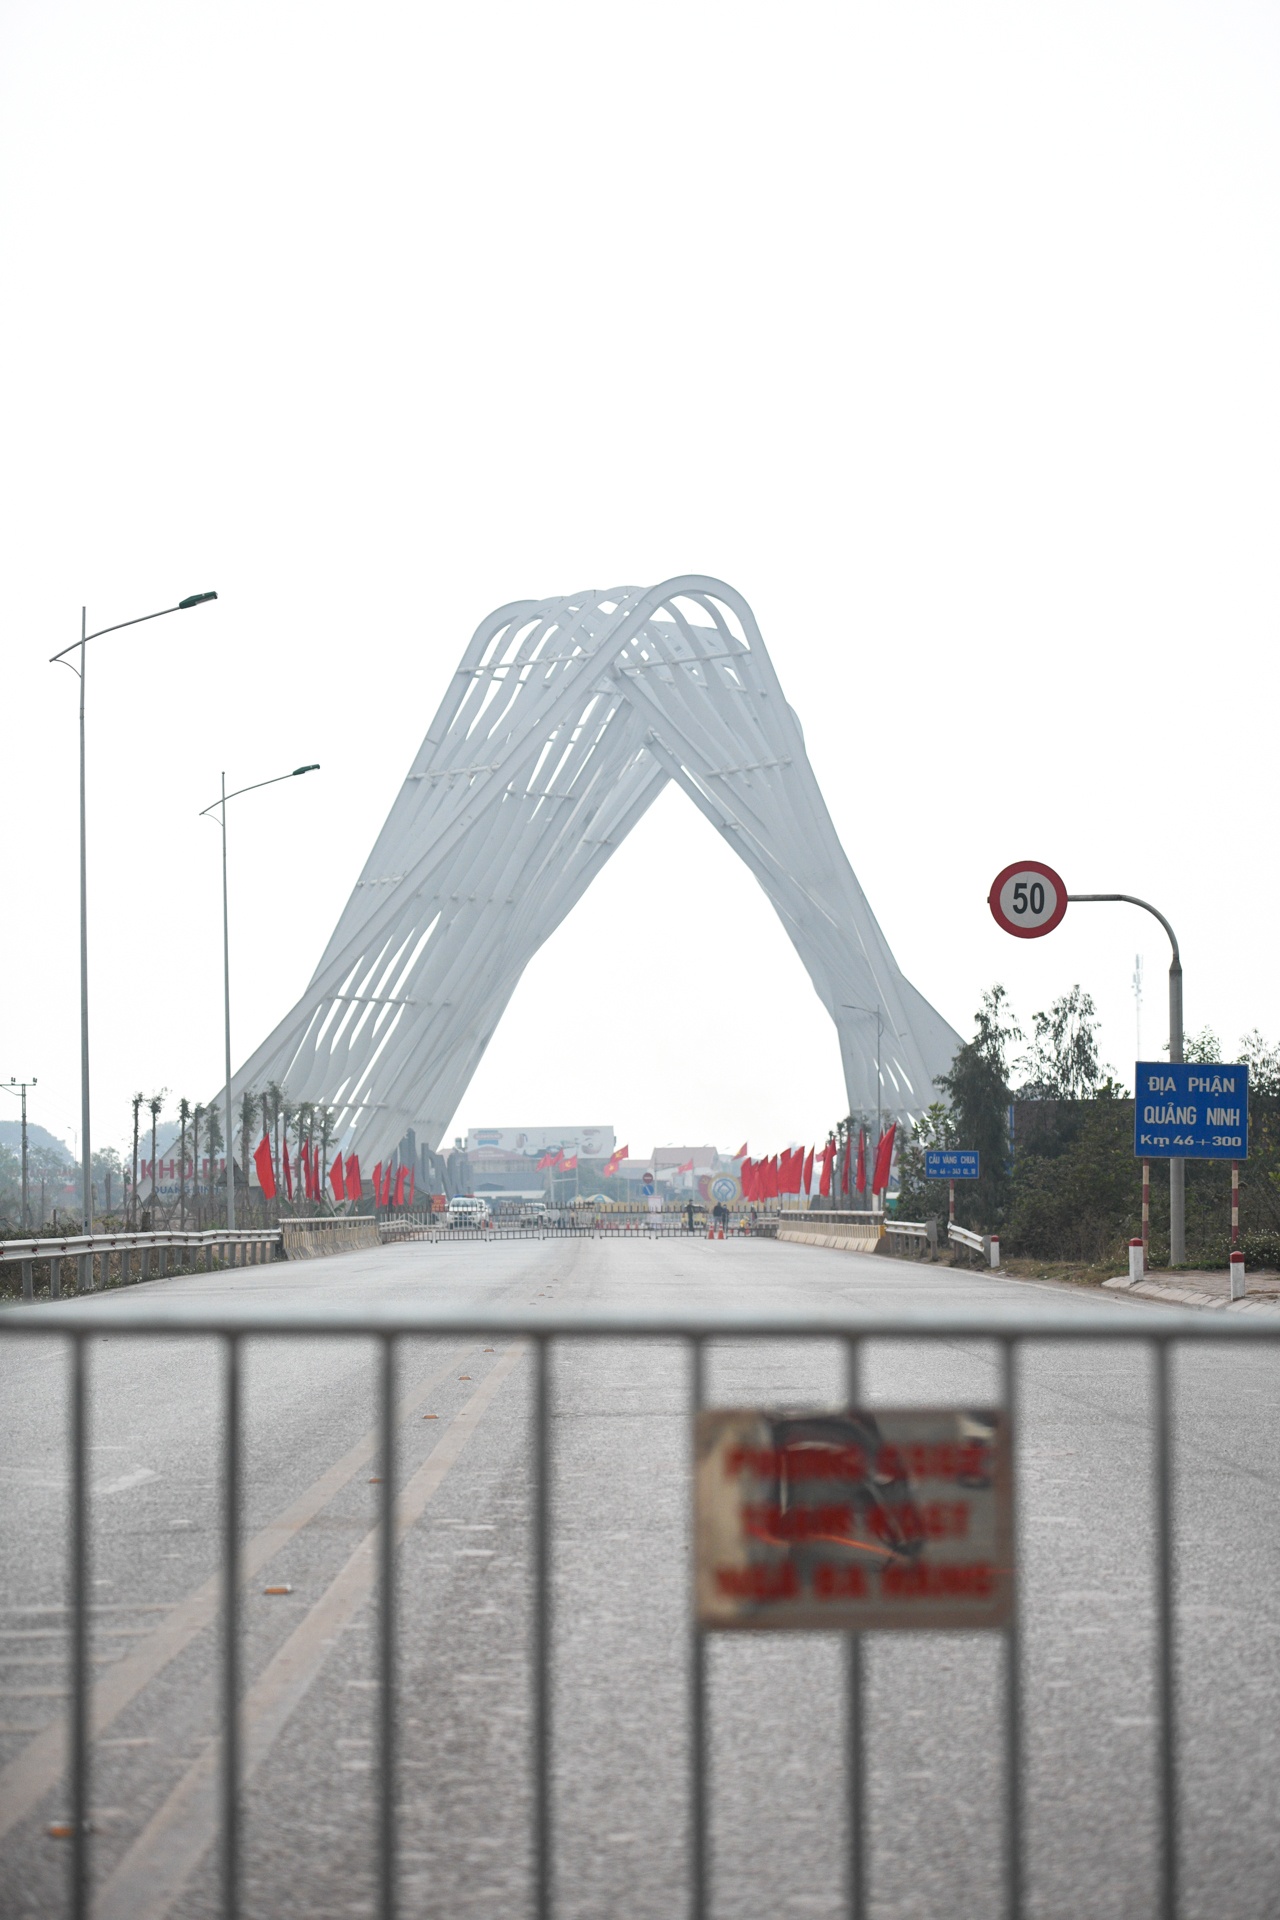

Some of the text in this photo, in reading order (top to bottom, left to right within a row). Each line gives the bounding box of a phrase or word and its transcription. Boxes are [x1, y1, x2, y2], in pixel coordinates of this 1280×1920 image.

[1012, 882, 1045, 915] 50
[1147, 1075, 1235, 1097] ĐỊA PHẬN
[1143, 1101, 1240, 1127] QUẢNG NINH
[1140, 1134, 1170, 1147] Km
[141, 1159, 194, 1180] KHU
